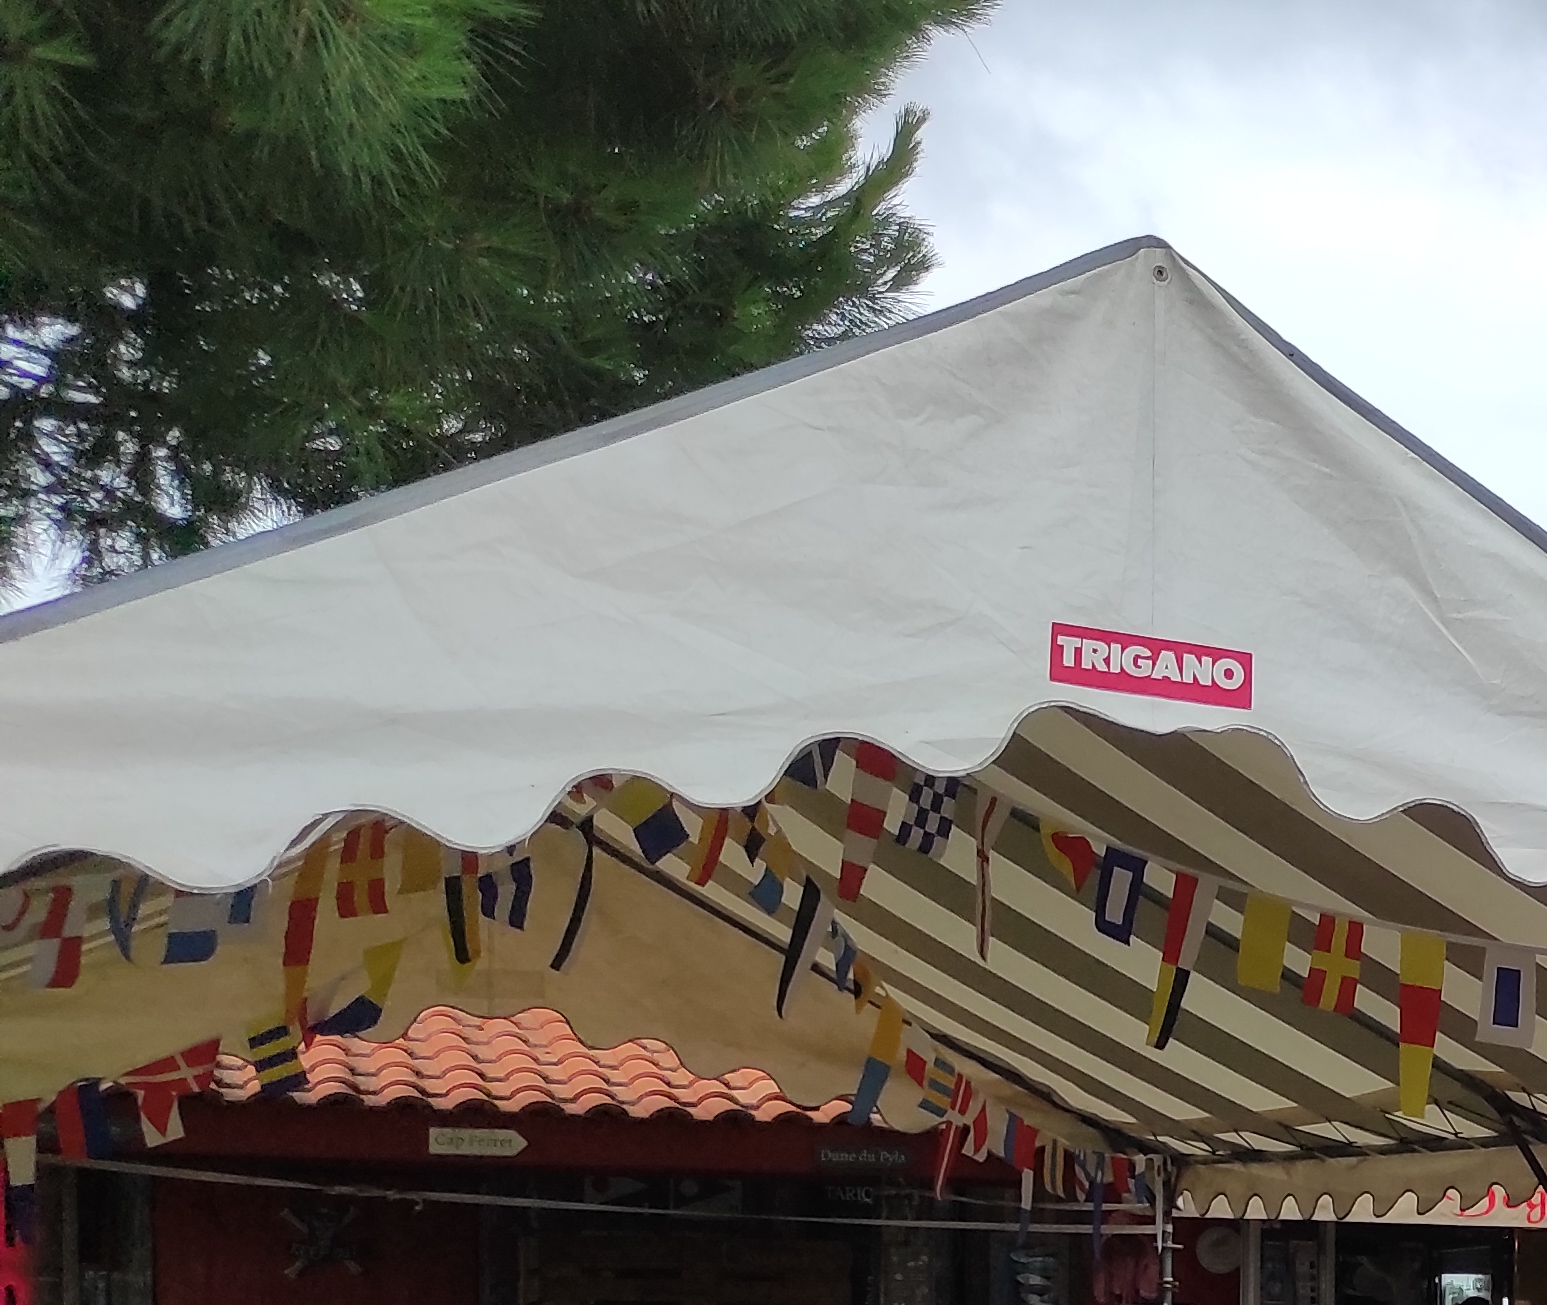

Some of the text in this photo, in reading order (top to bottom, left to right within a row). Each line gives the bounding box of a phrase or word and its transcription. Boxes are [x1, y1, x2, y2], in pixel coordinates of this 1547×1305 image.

[1057, 635, 1244, 689] TRIGANO
[435, 1134, 464, 1149] Cap
[821, 1150, 856, 1161] Dune
[859, 1150, 875, 1161] du
